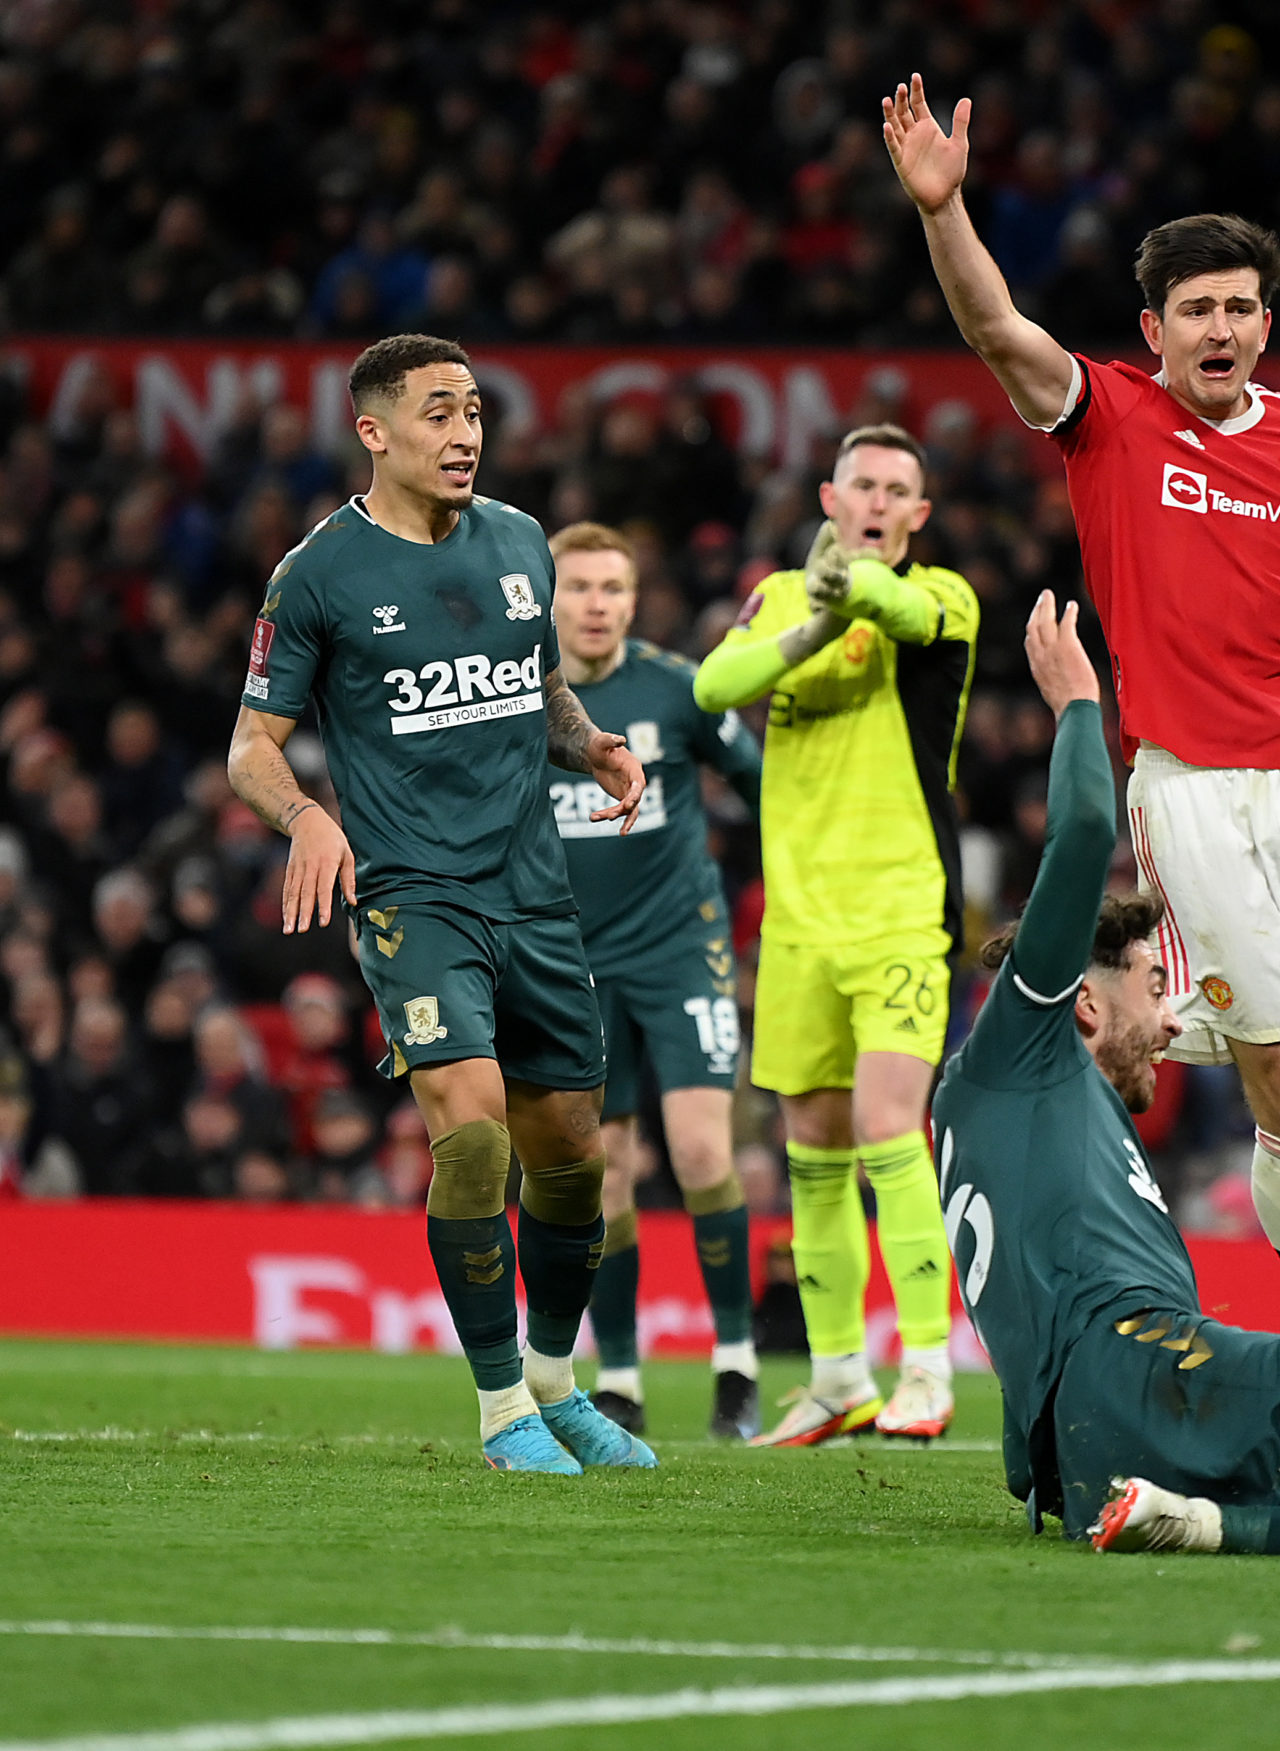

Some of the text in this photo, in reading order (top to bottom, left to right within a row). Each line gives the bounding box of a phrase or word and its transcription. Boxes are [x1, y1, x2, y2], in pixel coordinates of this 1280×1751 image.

[383, 643, 541, 712] 32Red
[427, 699, 526, 727] SET YOUR LIMITS
[884, 963, 938, 1017] 26
